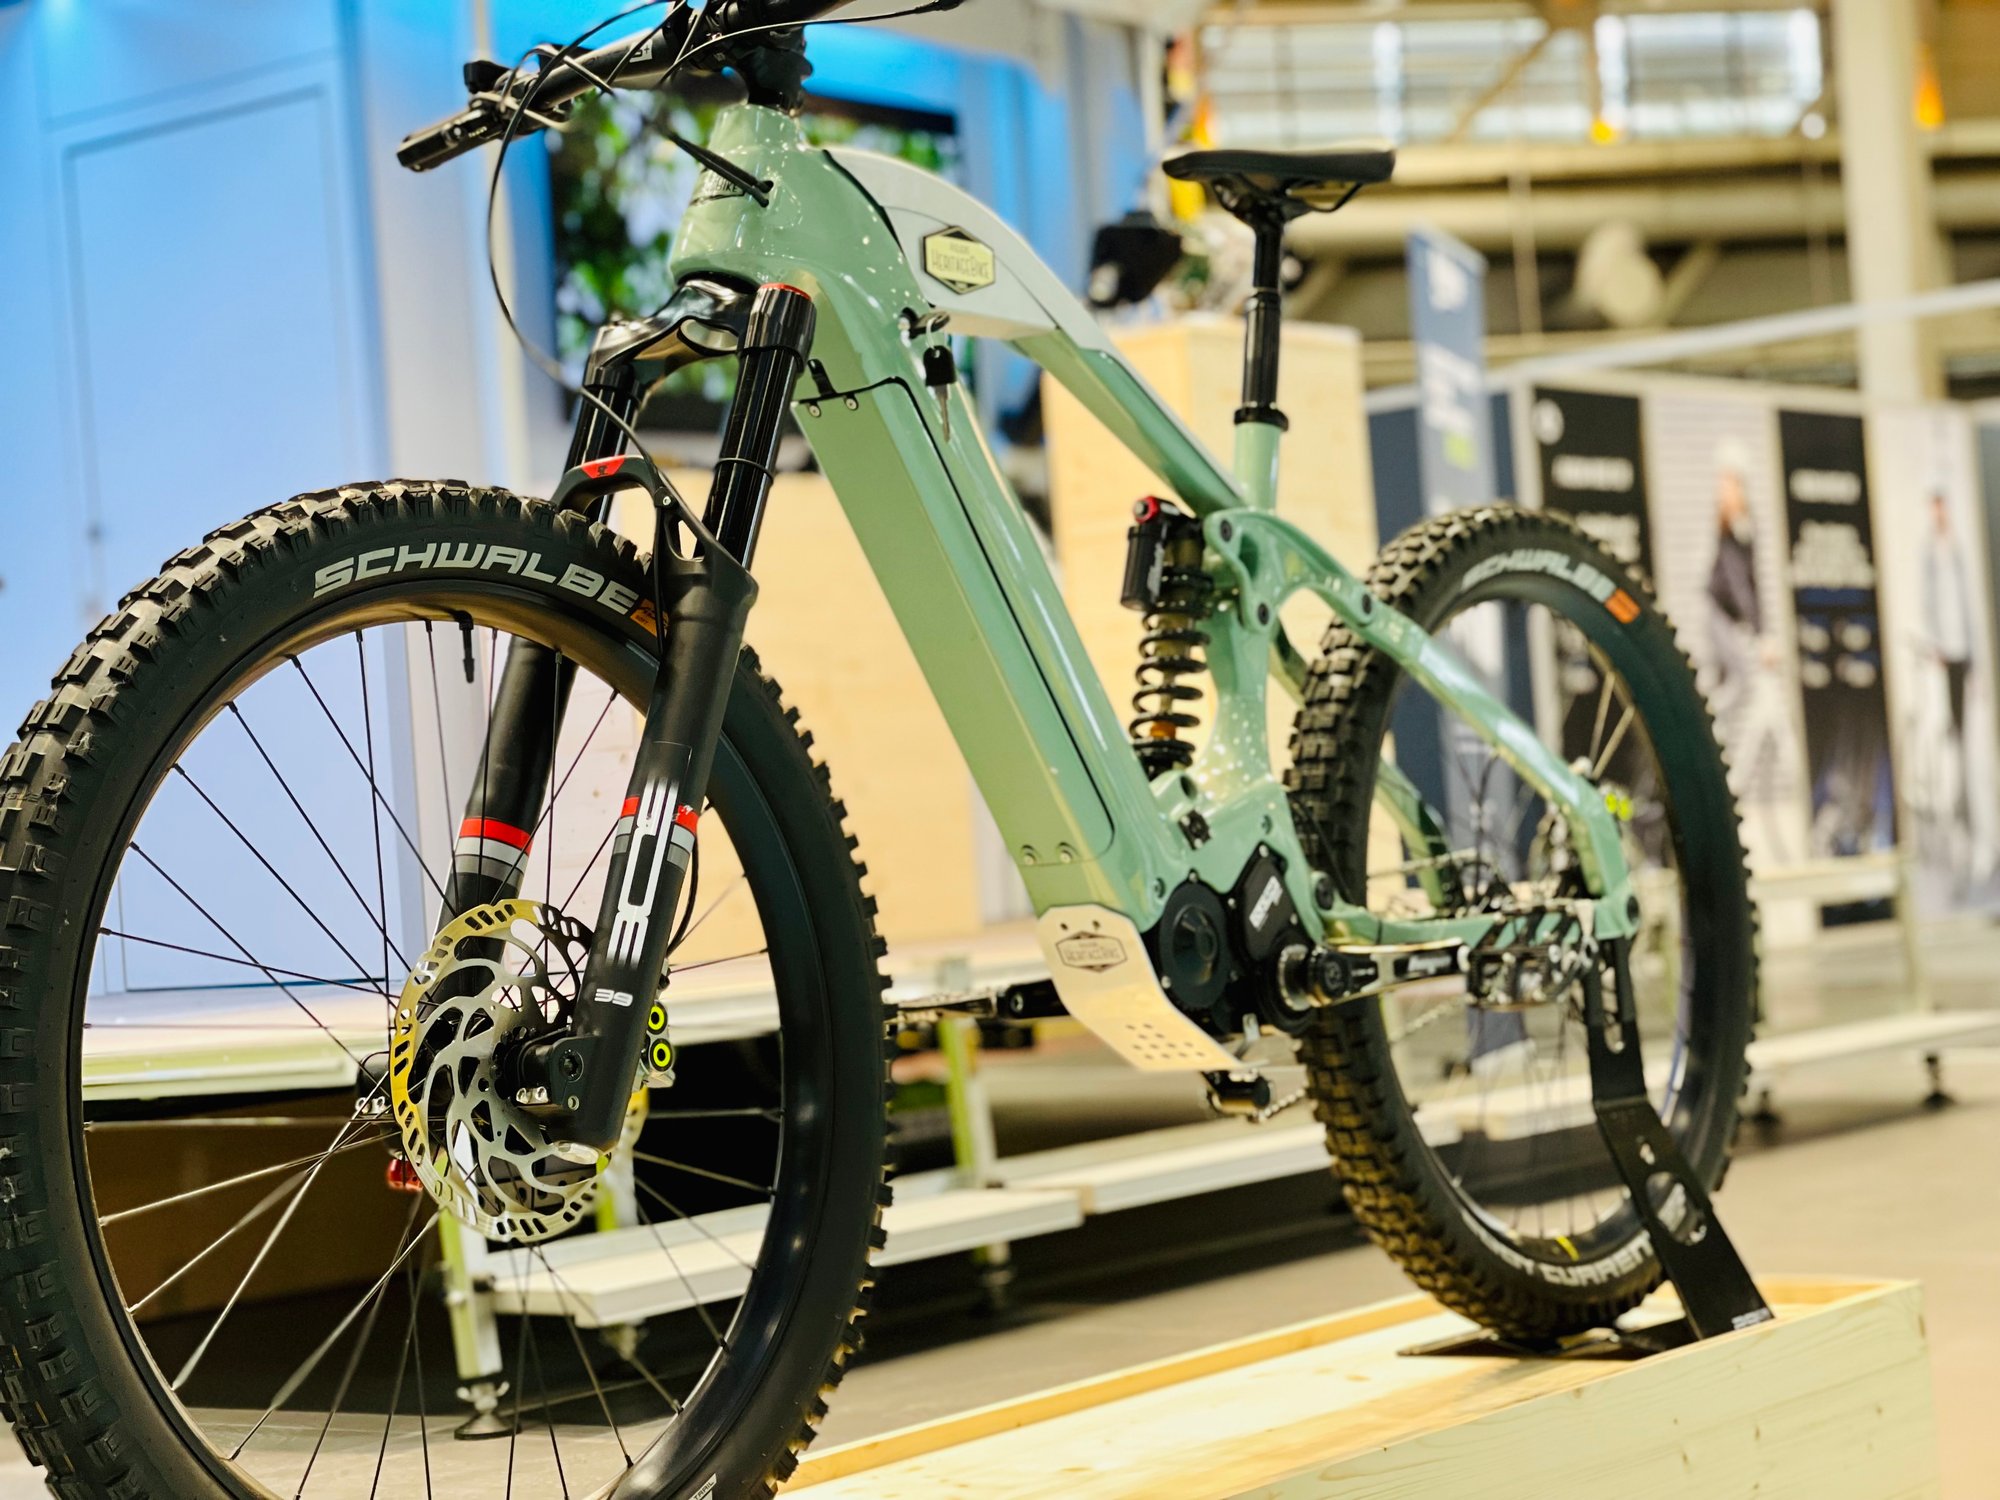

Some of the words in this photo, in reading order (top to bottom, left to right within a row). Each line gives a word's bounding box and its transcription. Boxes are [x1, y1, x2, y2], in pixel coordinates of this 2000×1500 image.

[313, 542, 639, 615] SCHWALBE
[1538, 1229, 1655, 1286] CURREN
[693, 1481, 715, 1500] TRAIL
